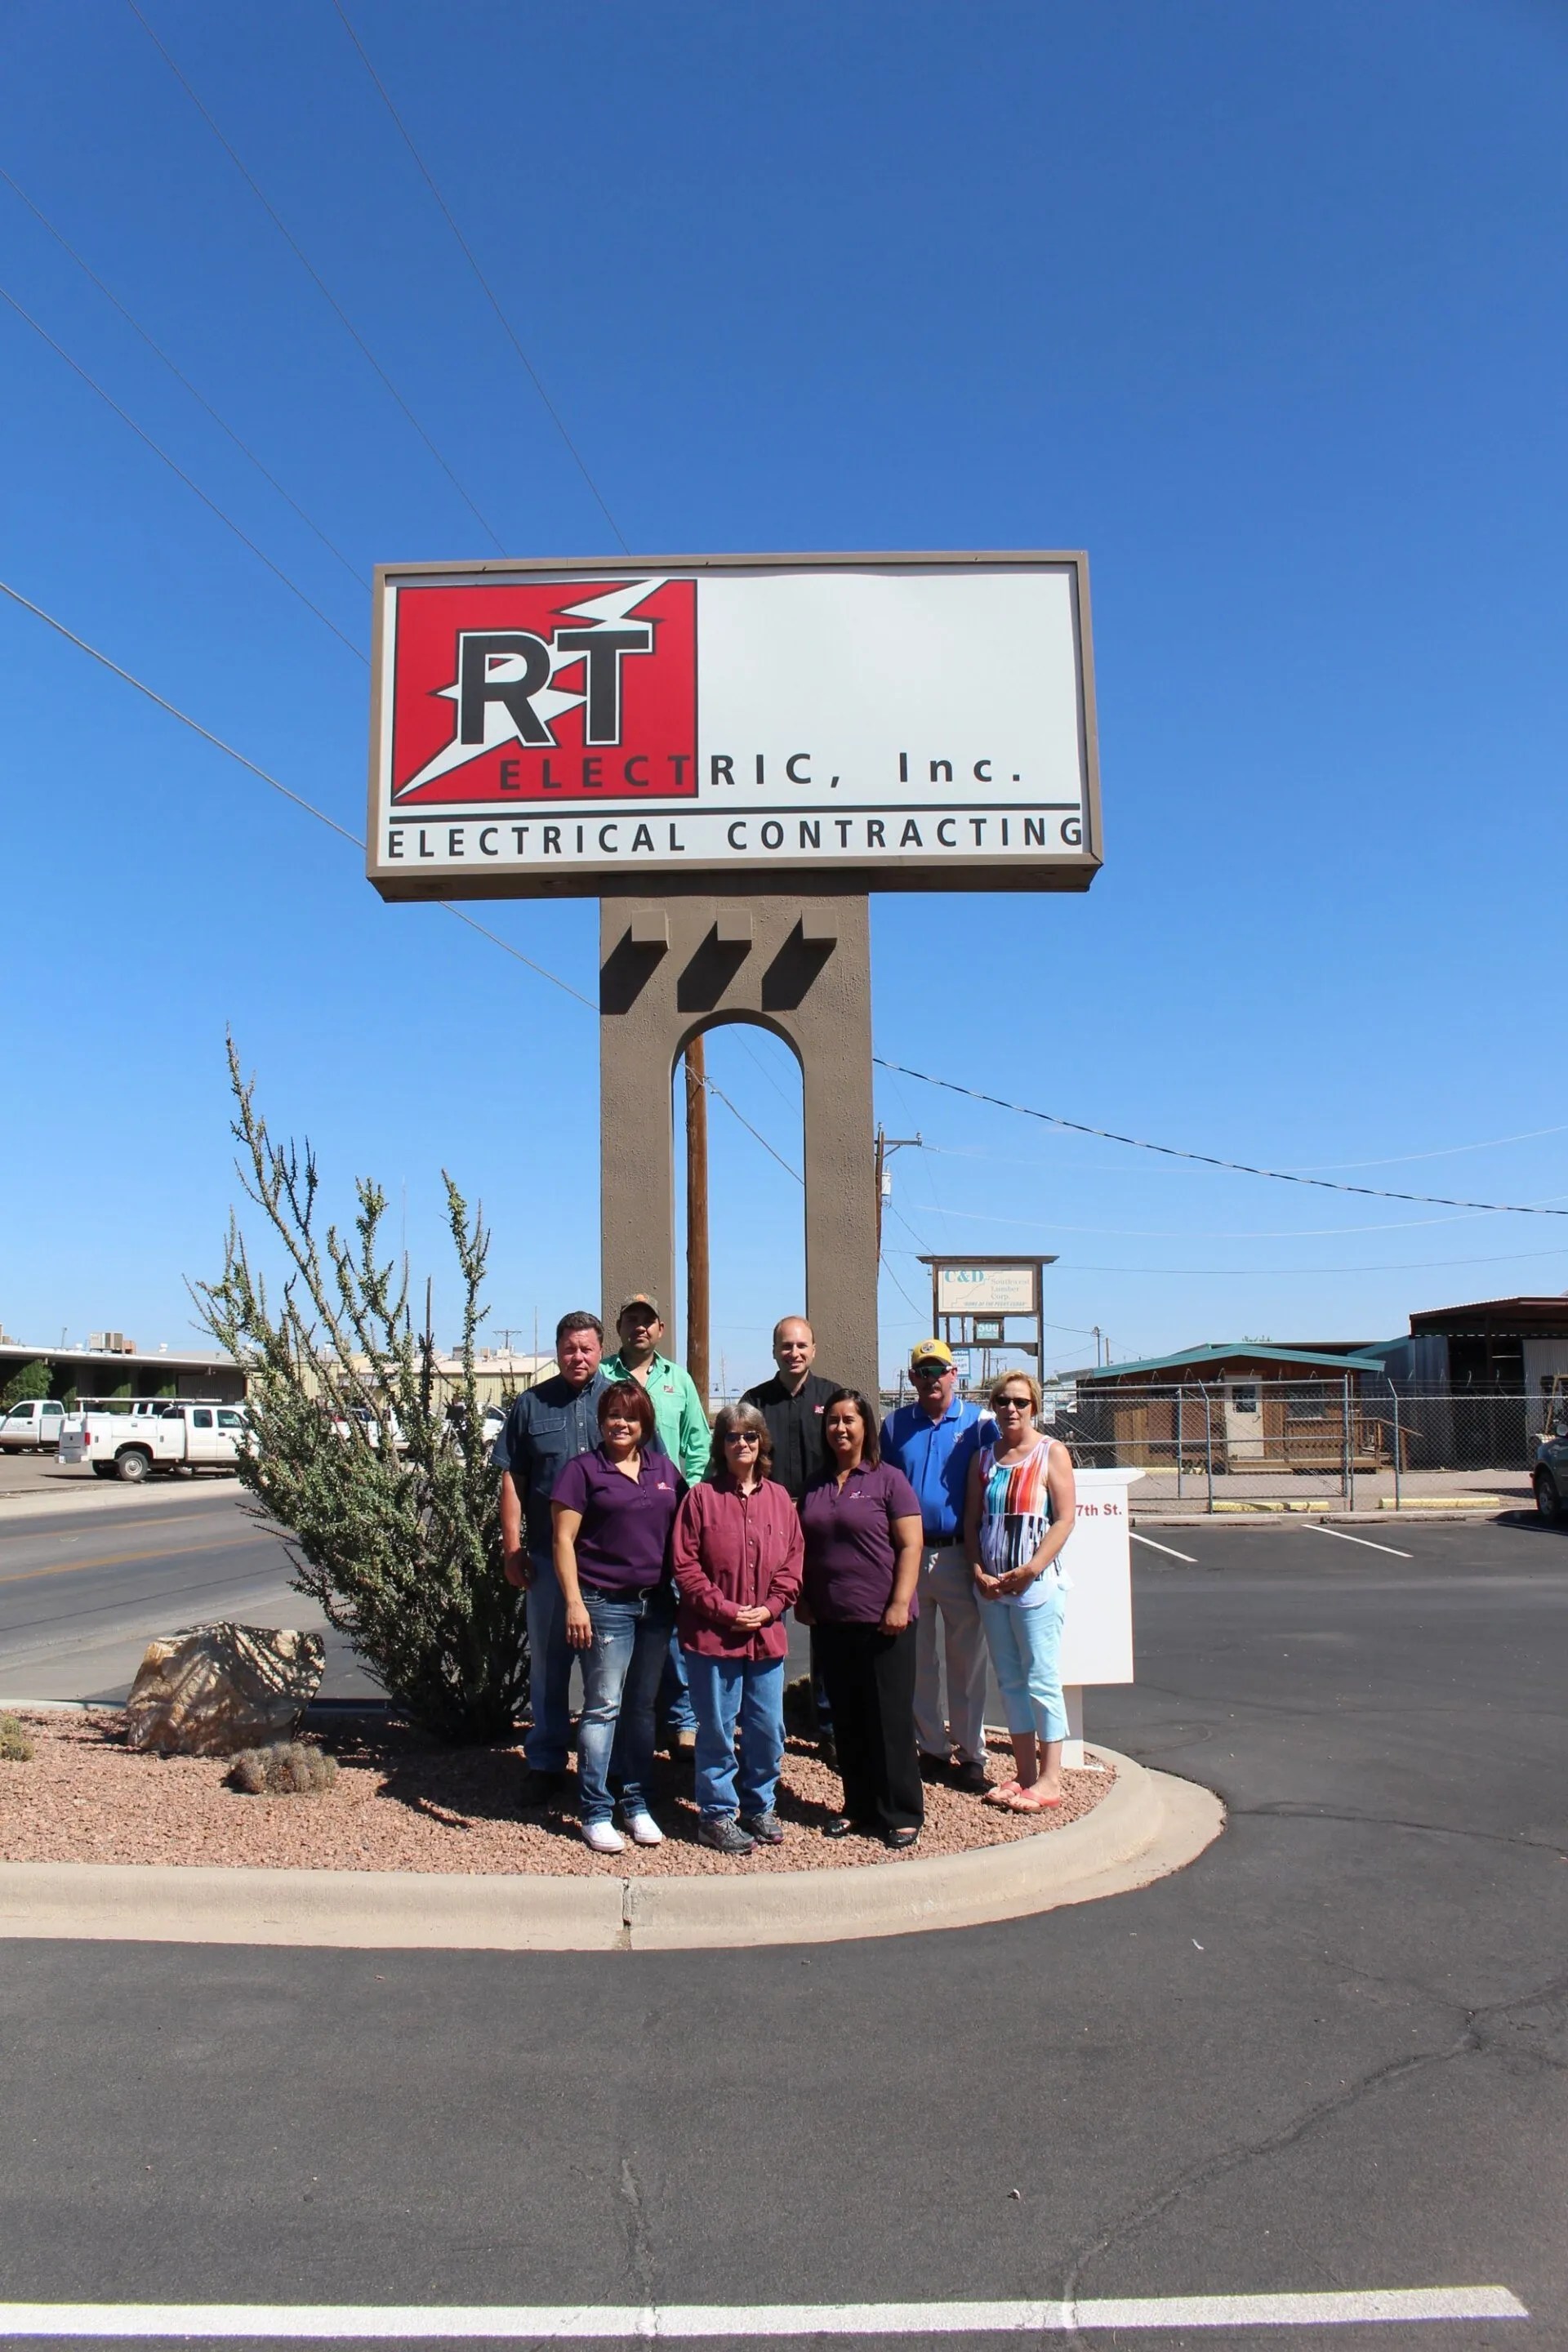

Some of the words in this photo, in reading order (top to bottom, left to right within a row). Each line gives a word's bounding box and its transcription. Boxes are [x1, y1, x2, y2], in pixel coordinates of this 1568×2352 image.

[461, 629, 649, 746] RT
[499, 753, 840, 790] ELECTRIC,
[898, 752, 1021, 783] Inc.
[388, 822, 685, 858] ELECTRICAL
[726, 817, 1082, 850] CONTRACTING
[945, 1269, 985, 1283] C&D
[1103, 1503, 1122, 1516] St.
